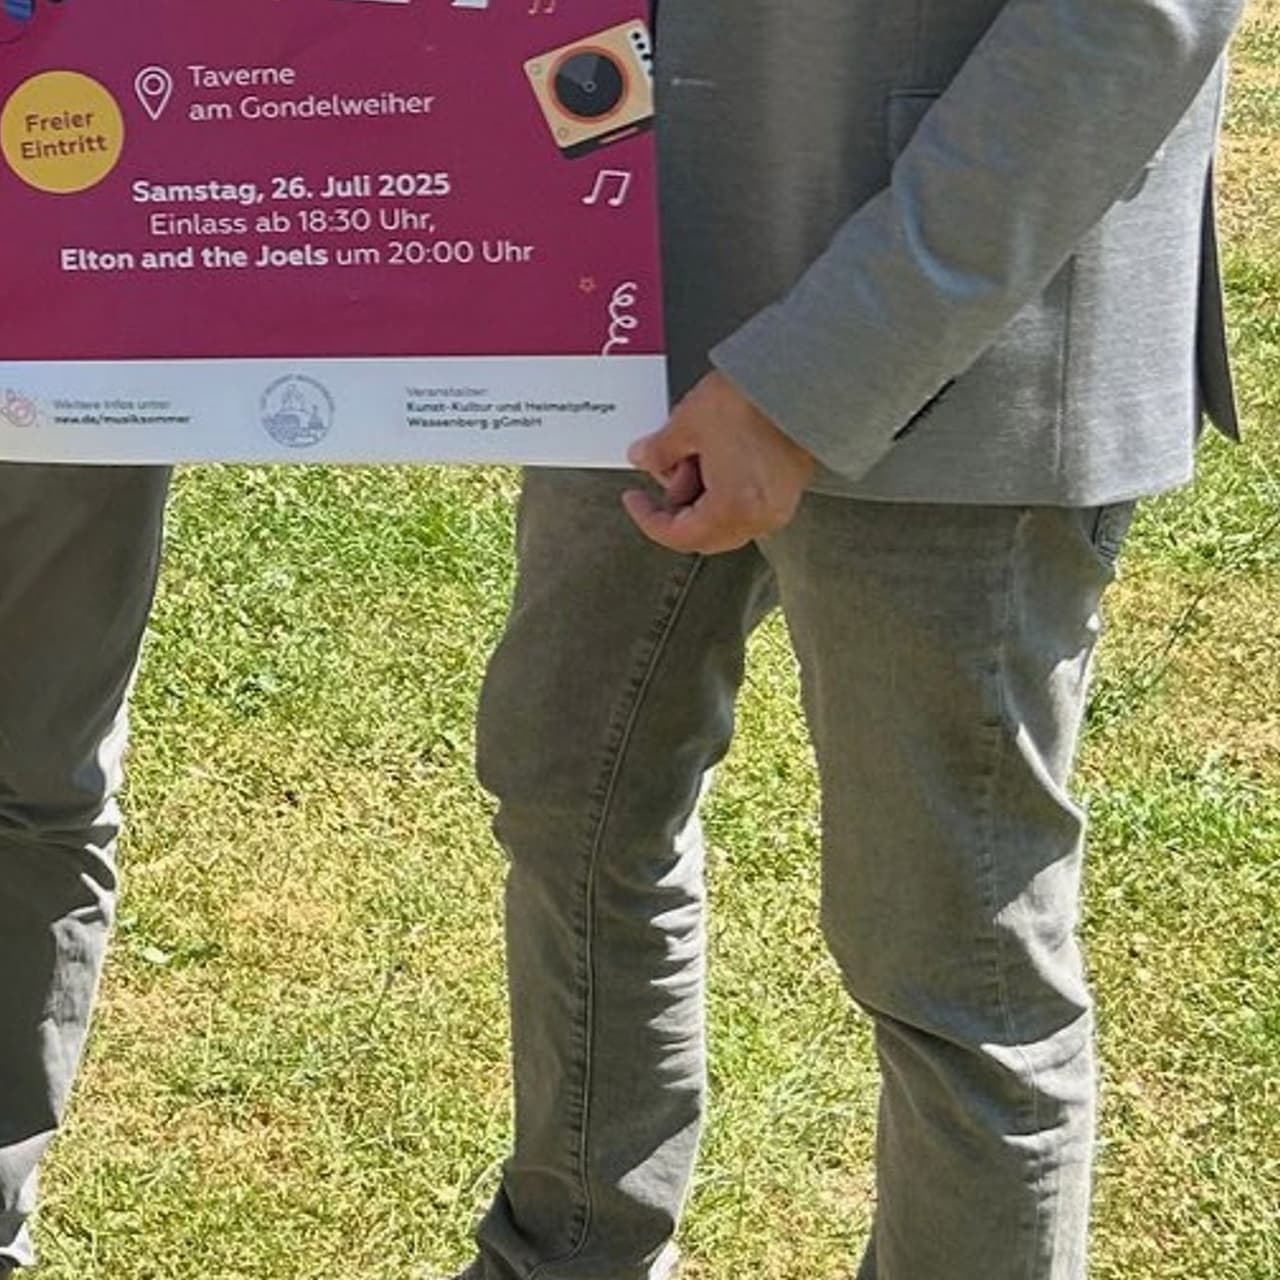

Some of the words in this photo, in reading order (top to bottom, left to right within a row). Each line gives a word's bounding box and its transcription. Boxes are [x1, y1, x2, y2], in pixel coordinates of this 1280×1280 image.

[188, 64, 296, 88] Taverne
[189, 100, 232, 120] am
[239, 93, 436, 118] Gondelweiher
[25, 110, 95, 133] Freier
[20, 134, 108, 161] Eintritt
[132, 178, 265, 204] Samstag,
[271, 177, 314, 200] 26.
[320, 174, 371, 198] Juli
[378, 173, 451, 197] 2025
[150, 211, 247, 236] Einlass
[255, 210, 290, 233] ab
[298, 209, 372, 233] 18:30
[380, 208, 437, 234] Uhr,
[60, 248, 134, 271] Elton
[141, 245, 193, 269] and
[201, 245, 248, 268] the
[255, 243, 329, 268] Joels
[336, 246, 380, 266] um
[387, 241, 475, 265] 20:00
[483, 239, 535, 263] Uhr
